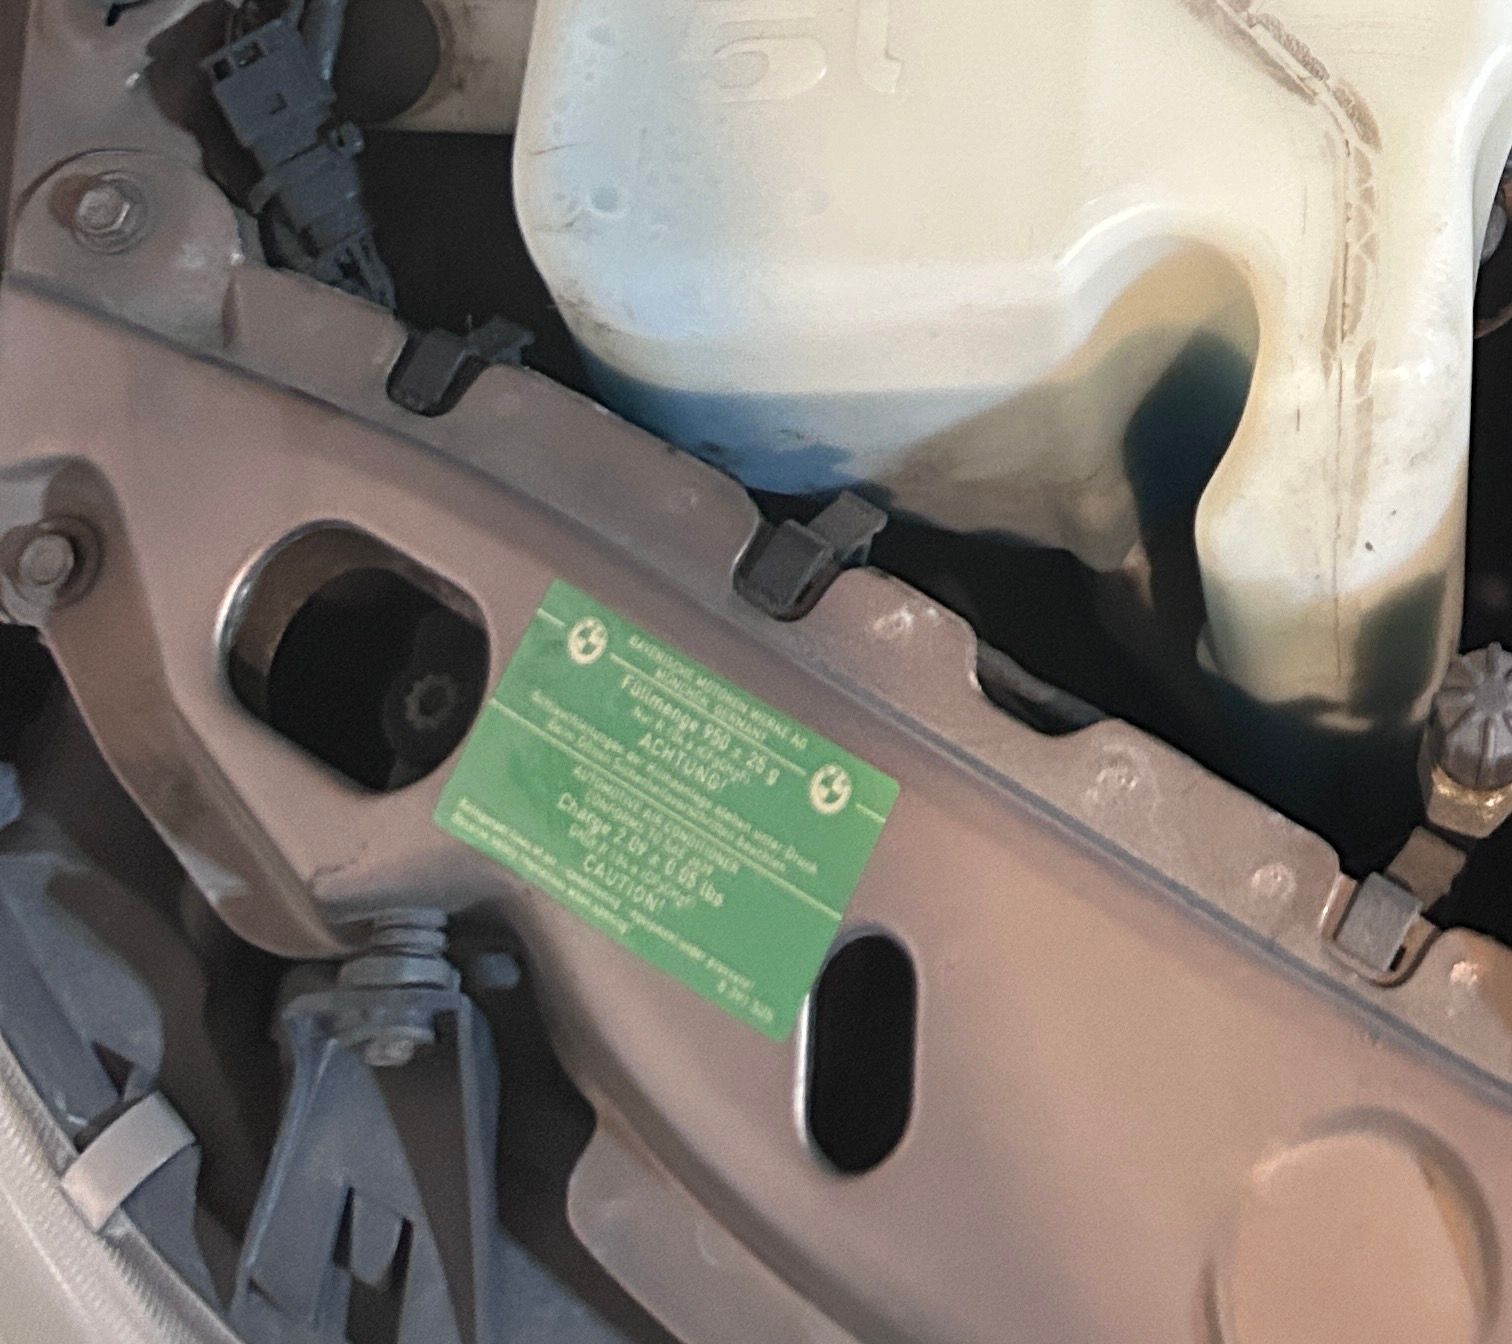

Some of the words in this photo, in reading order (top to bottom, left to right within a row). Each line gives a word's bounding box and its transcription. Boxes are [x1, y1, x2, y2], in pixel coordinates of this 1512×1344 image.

[700, 721, 733, 752] 950
[554, 790, 615, 842] Charge
[697, 878, 727, 909] lbs
[580, 852, 665, 916] CAUTION!
